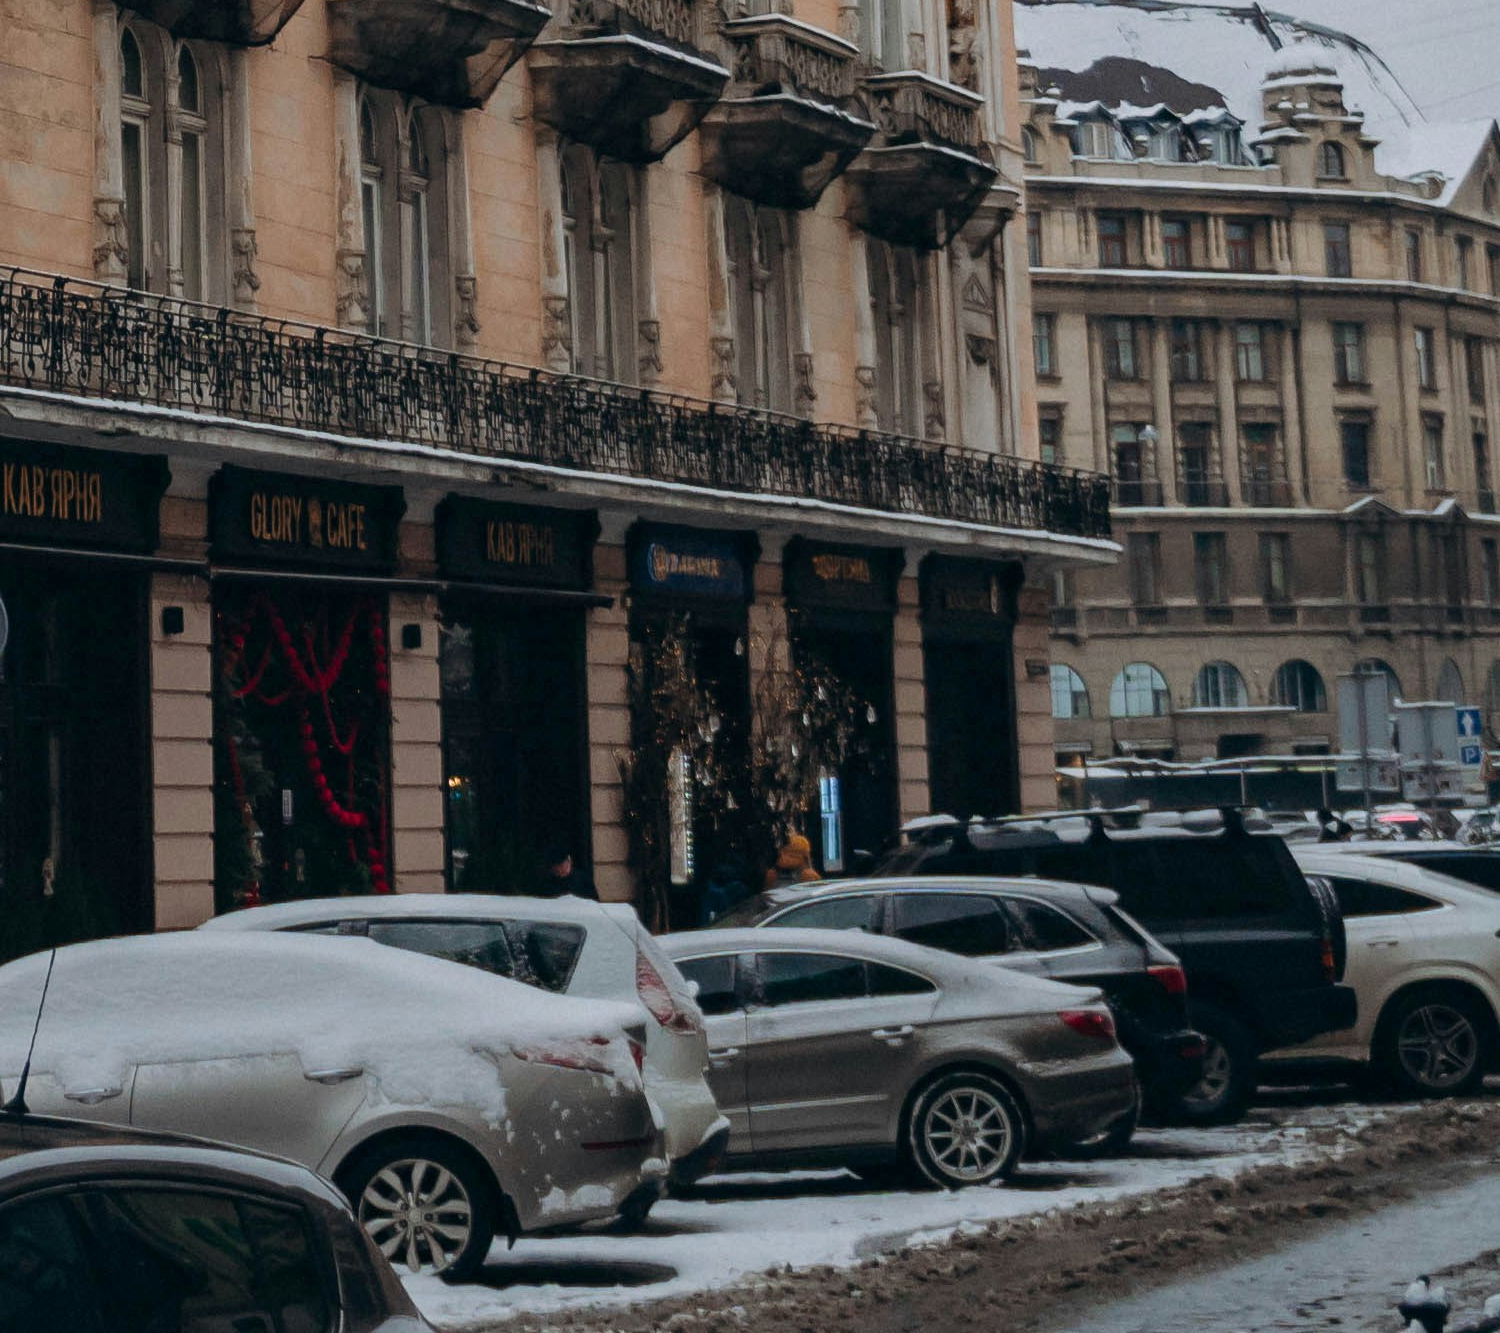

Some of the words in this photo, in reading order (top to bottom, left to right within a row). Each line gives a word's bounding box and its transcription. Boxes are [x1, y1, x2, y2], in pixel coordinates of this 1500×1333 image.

[3, 461, 102, 523] КАВ'ЯРНЯ
[250, 492, 303, 543] GLORY
[326, 501, 367, 550] CAFE
